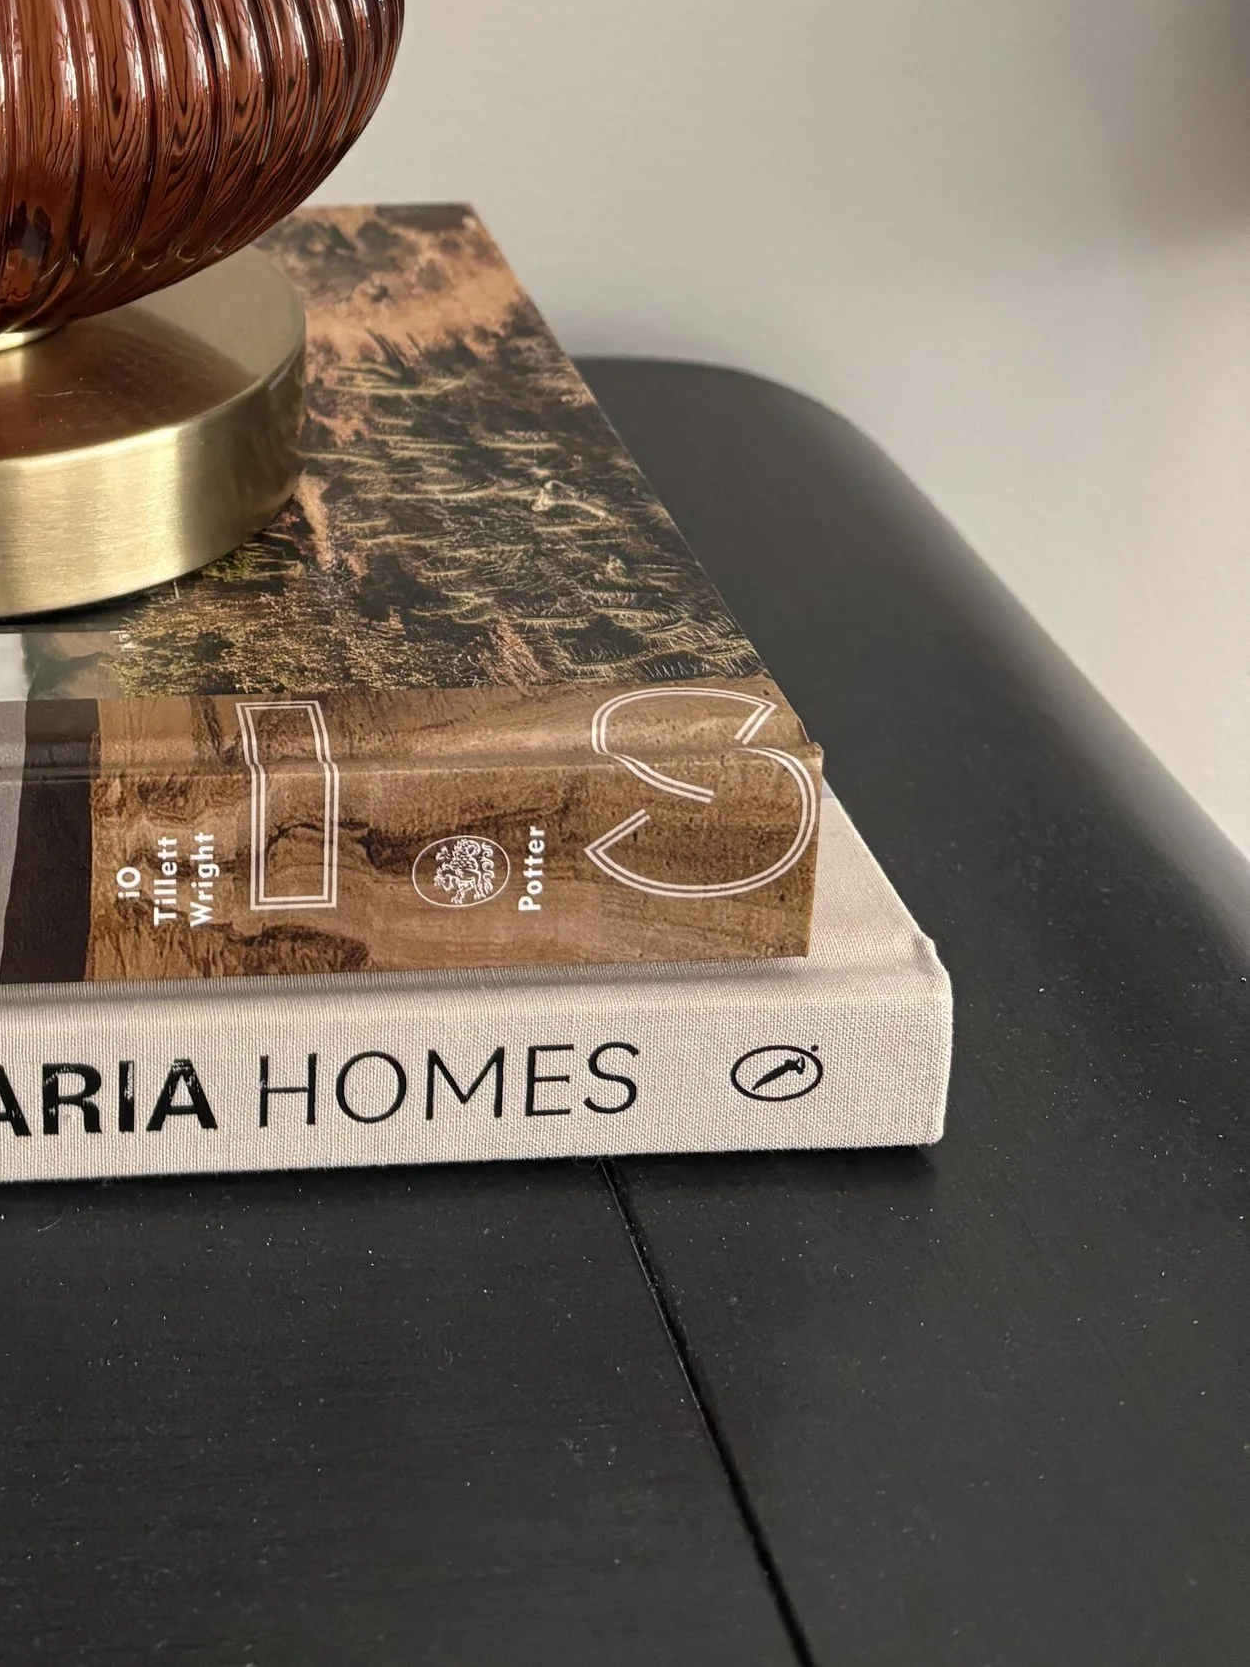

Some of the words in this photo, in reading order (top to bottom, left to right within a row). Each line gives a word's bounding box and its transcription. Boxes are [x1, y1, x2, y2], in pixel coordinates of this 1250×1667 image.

[116, 866, 141, 899] iO
[153, 836, 178, 927] Tillett
[190, 832, 220, 927] Wright
[518, 826, 545, 912] Potter
[258, 1041, 640, 1128] HOMES
